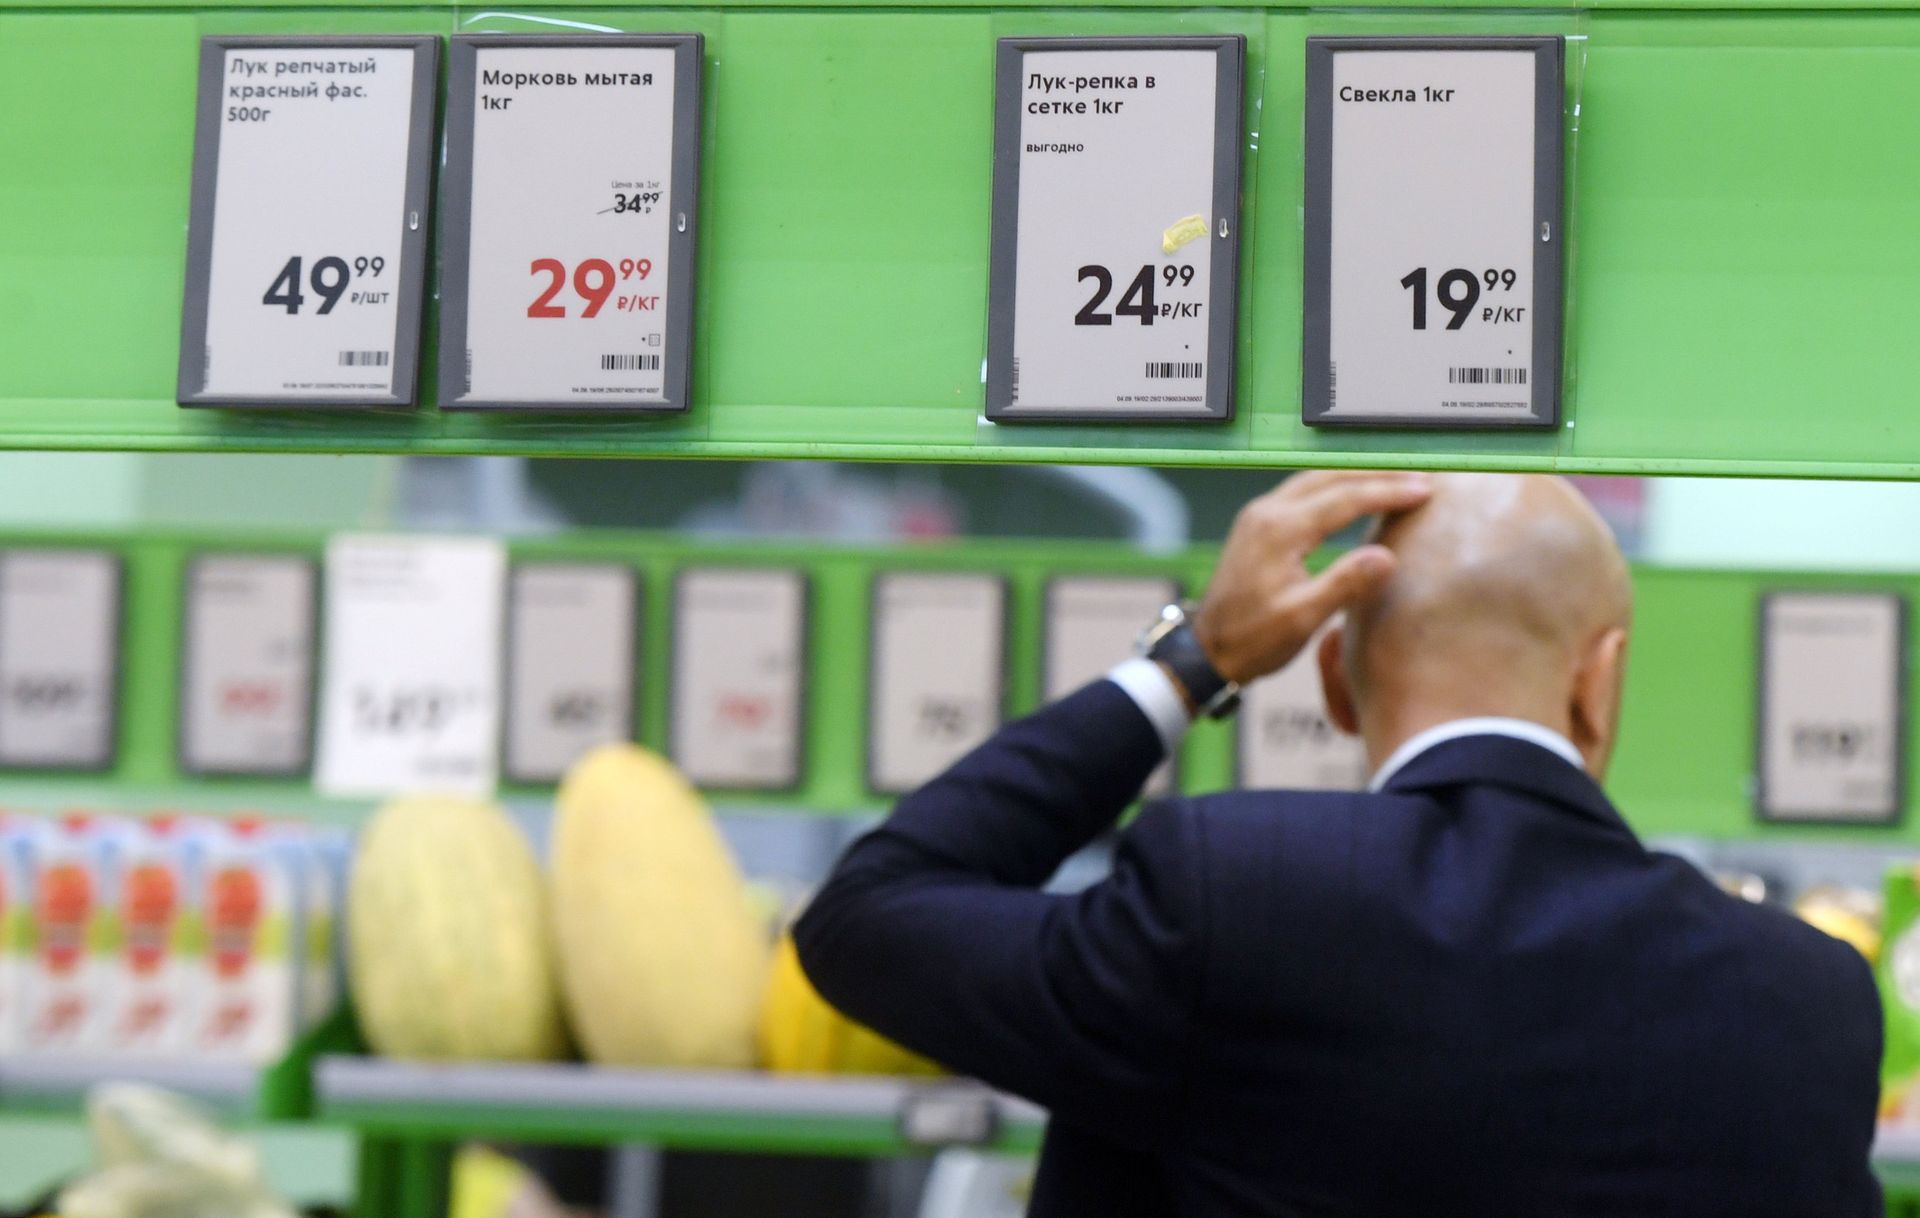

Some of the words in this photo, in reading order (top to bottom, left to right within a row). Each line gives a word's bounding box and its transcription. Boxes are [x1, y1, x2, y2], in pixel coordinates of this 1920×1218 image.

[230, 58, 268, 78] Лук
[276, 57, 376, 78] репчатый
[482, 69, 578, 90] Морковь
[584, 73, 653, 86] мытая
[1028, 73, 1138, 94] Лук-репка
[1146, 76, 1156, 89] в
[229, 81, 319, 102] красный
[326, 81, 368, 102] фас.
[1339, 86, 1416, 102] Свекла
[1423, 86, 1455, 102] 1кг
[481, 95, 513, 110] 1кг
[1027, 101, 1087, 115] сетке
[1093, 98, 1124, 114] 1кг
[228, 106, 271, 122] 500г
[1026, 143, 1084, 154] выгодно
